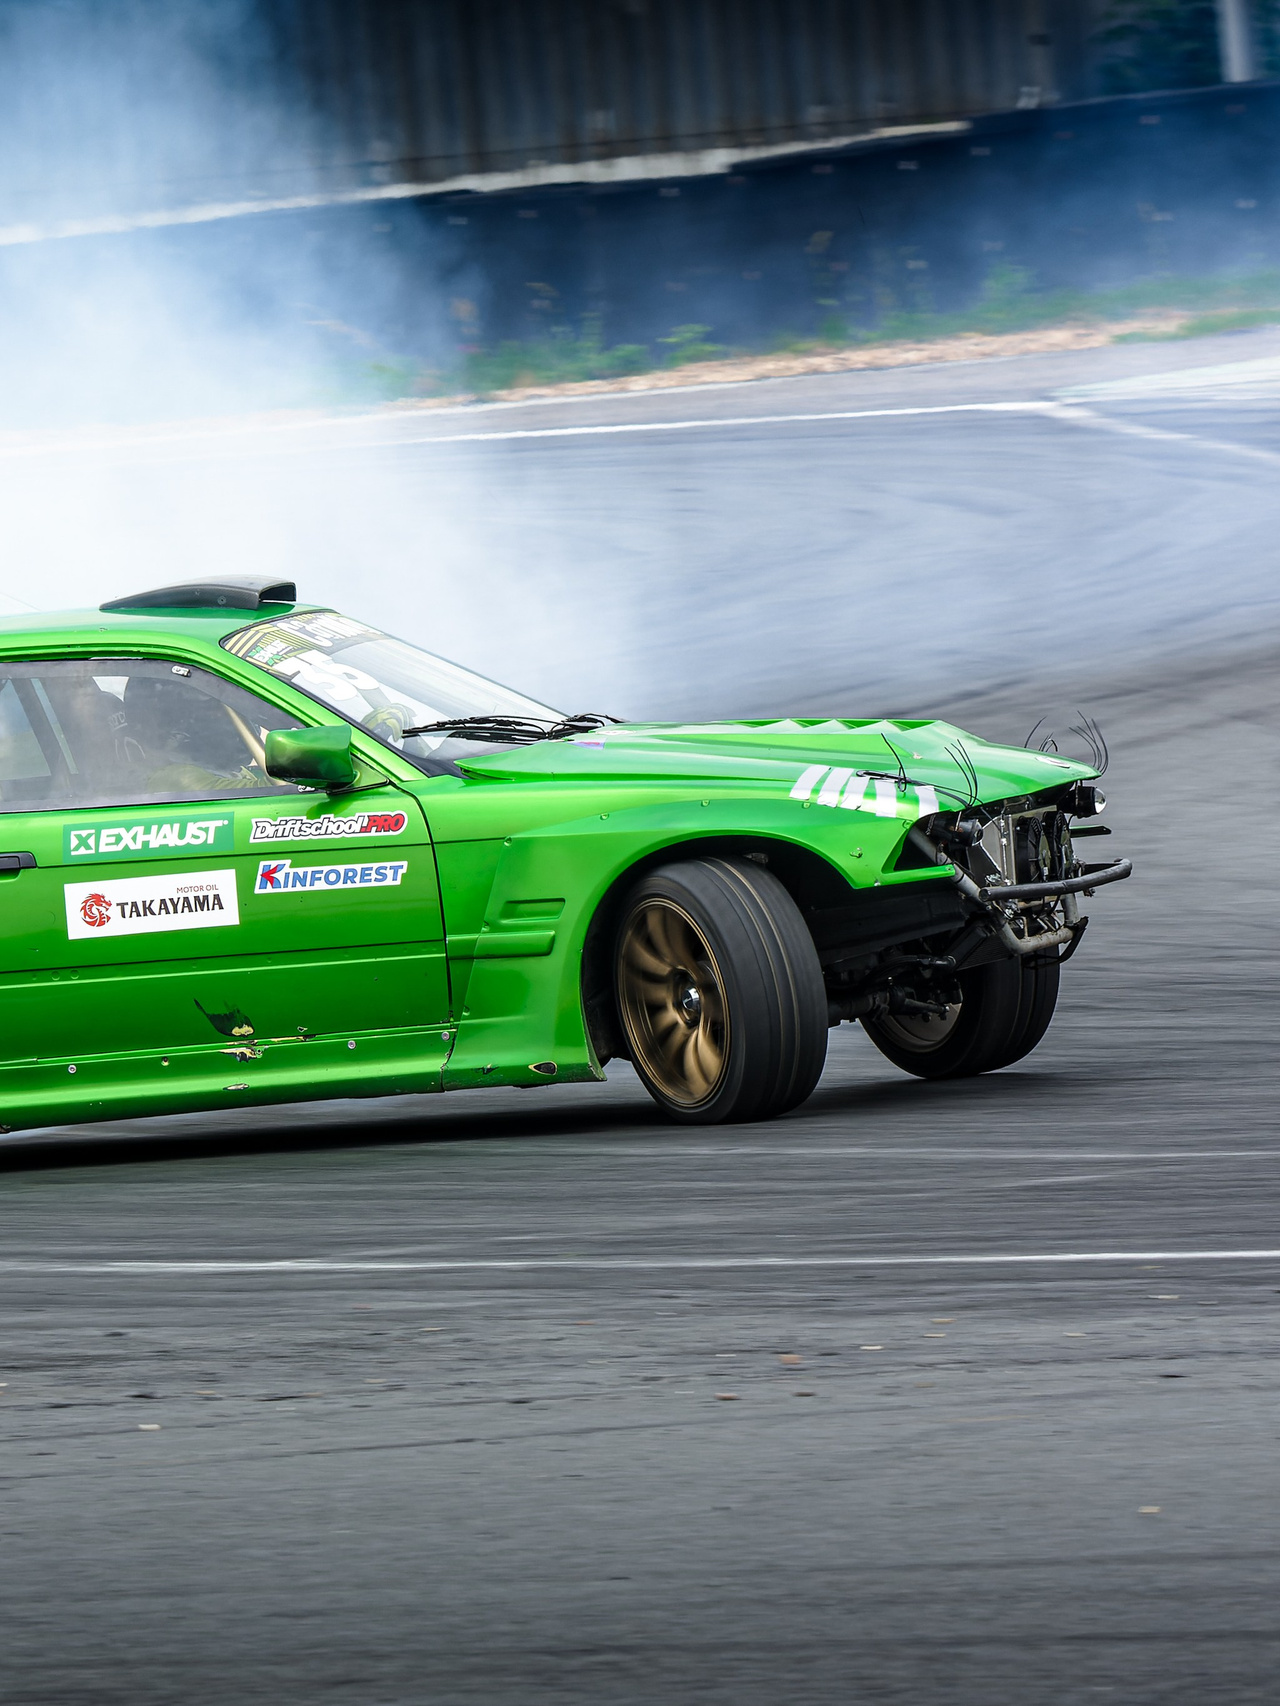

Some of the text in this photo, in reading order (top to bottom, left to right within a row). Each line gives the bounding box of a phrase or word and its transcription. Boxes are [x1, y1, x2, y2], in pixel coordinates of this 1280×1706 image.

[98, 820, 224, 852] EXHAUST
[259, 864, 404, 889] KINFOREST
[176, 886, 204, 894] MOTOR
[116, 894, 224, 919] TAKAYAMA
